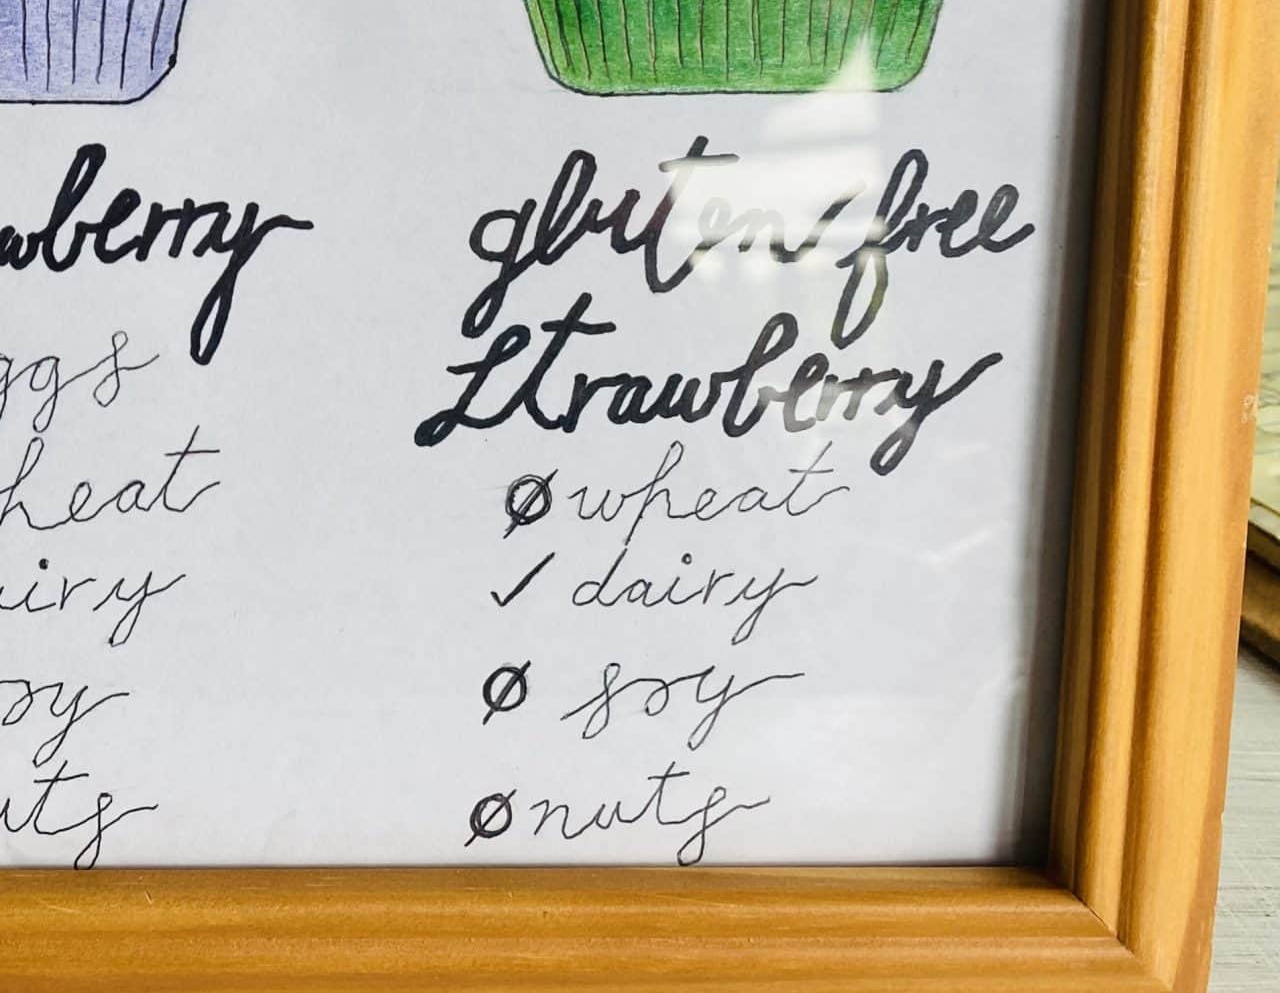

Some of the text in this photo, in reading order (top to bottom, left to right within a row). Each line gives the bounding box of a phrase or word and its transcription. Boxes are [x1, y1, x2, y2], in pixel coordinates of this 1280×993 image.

[834, 148, 1035, 348] free
[567, 440, 851, 546] wheat
[571, 549, 819, 646] dairy
[560, 662, 806, 751] soy
[529, 761, 772, 867] nuts
